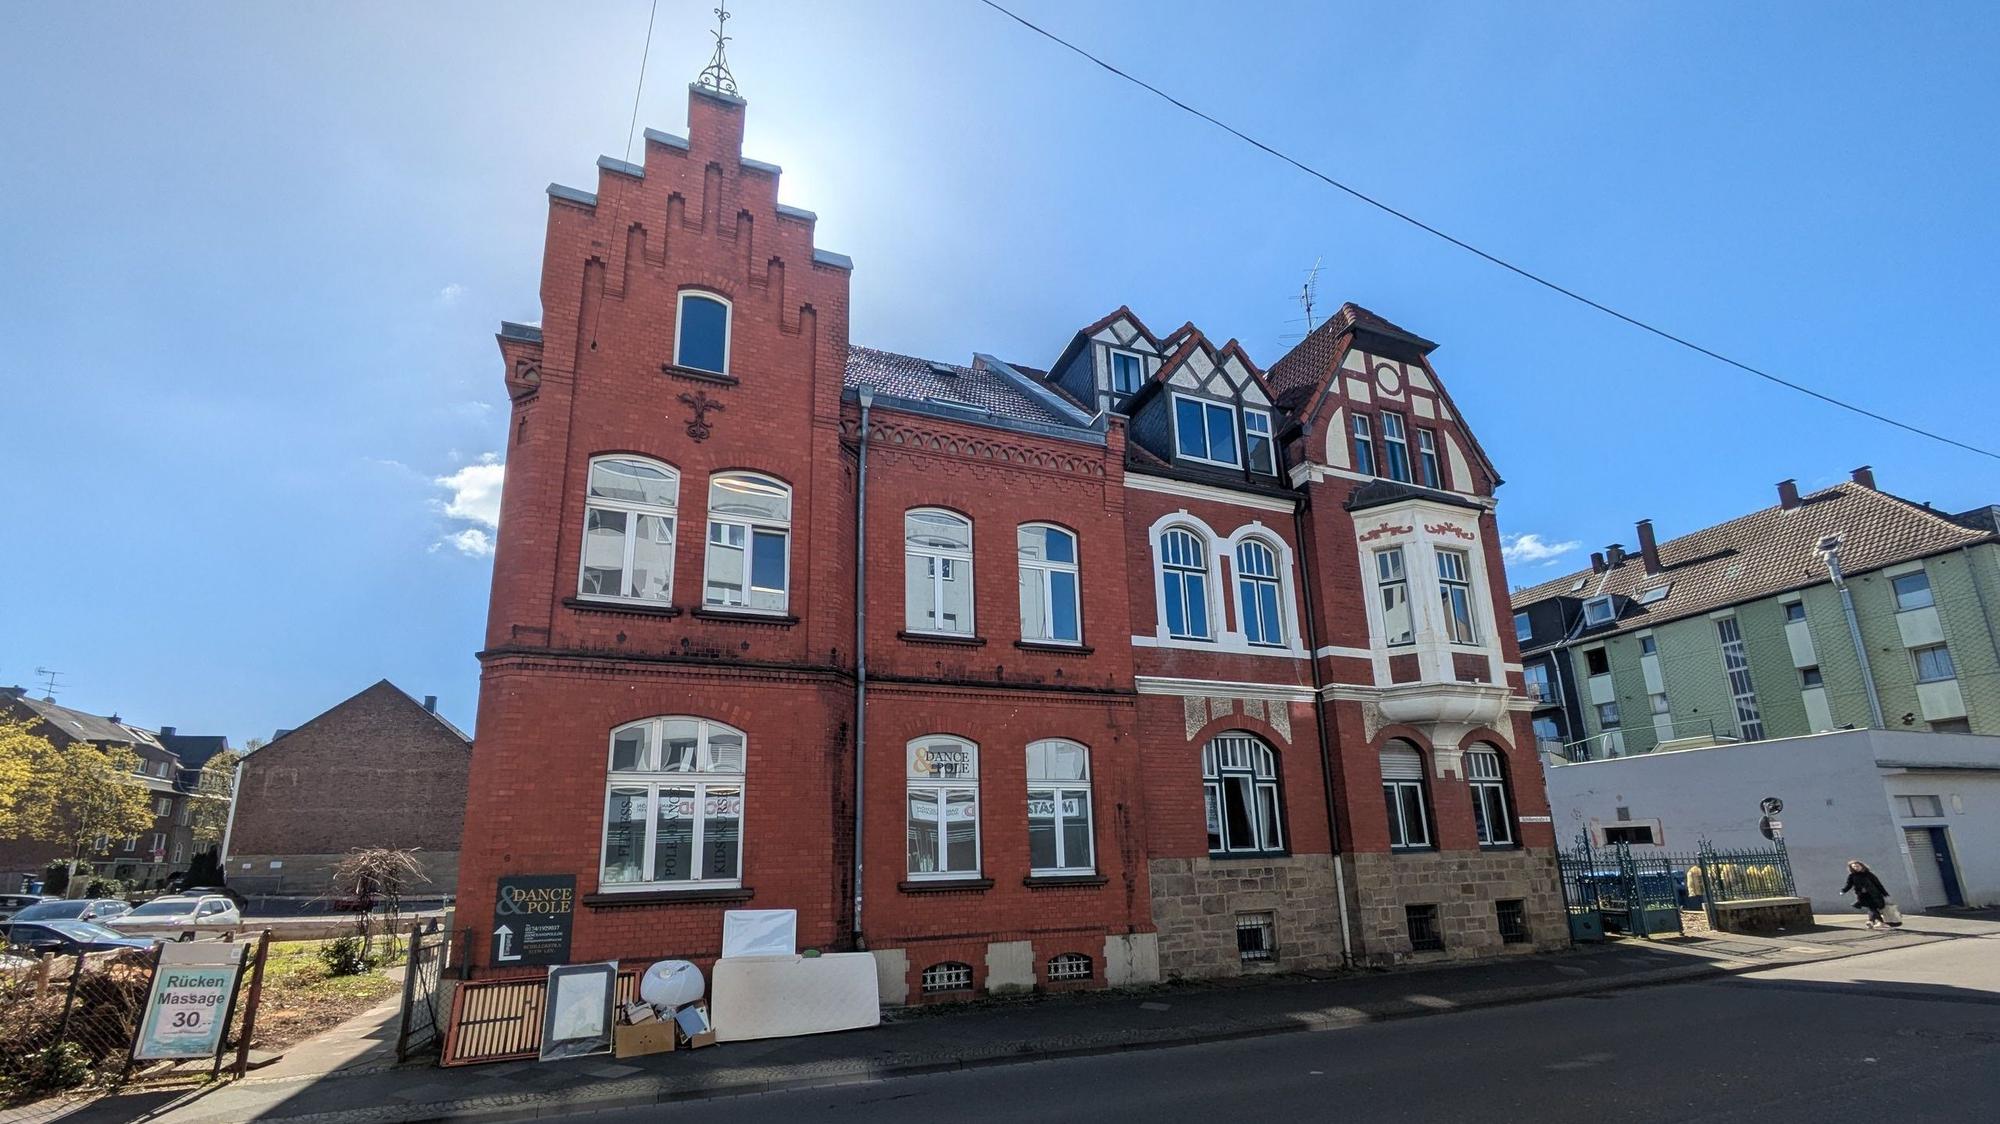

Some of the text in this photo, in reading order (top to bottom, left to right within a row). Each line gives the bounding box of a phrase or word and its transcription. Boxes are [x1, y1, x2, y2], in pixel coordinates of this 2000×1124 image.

[925, 751, 970, 763] DANCE
[937, 763, 970, 774] POLE
[665, 841, 678, 877] POLE
[714, 841, 726, 874] KIDS
[496, 885, 528, 915] &
[512, 888, 572, 902] DANCE
[527, 901, 571, 914] POLE
[167, 975, 224, 988] Rücken
[157, 992, 225, 1007] Massage
